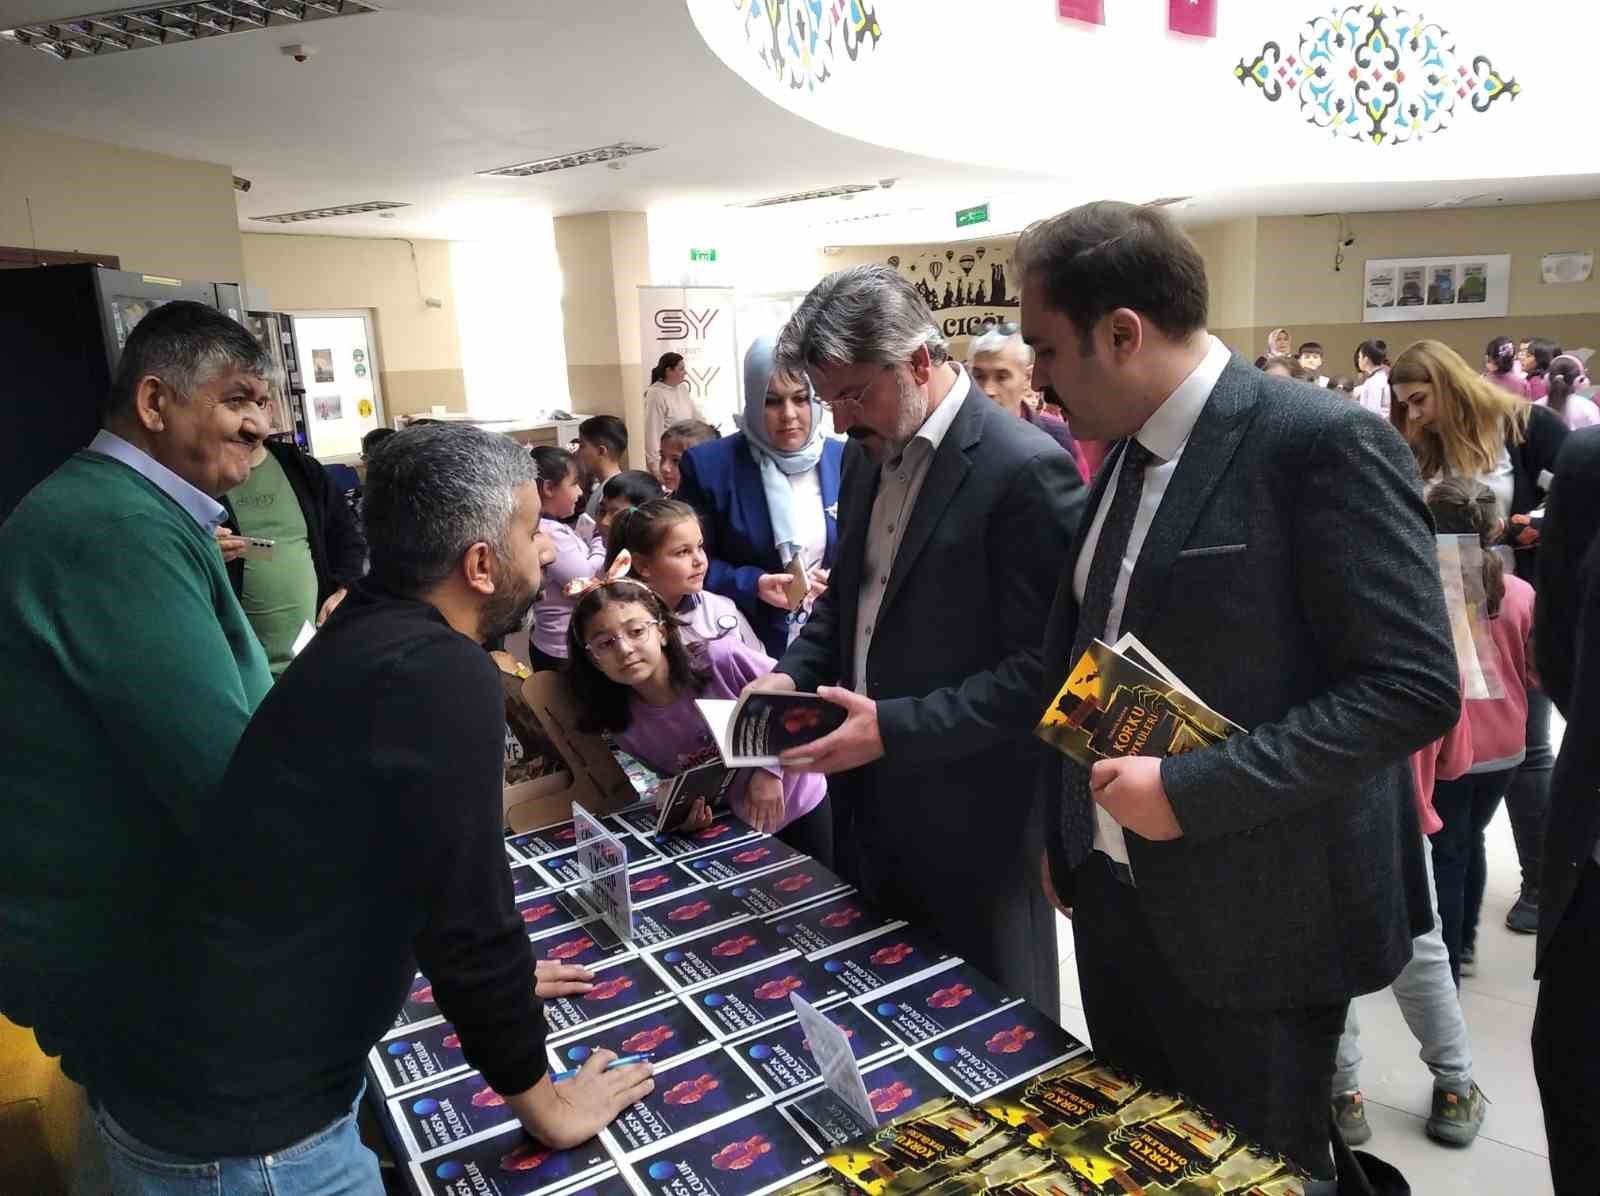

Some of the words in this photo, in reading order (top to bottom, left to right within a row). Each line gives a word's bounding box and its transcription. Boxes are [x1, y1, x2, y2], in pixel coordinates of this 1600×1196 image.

[1112, 705, 1145, 753] KORKU
[772, 1043, 812, 1082] YOLCULUK
[954, 1045, 1004, 1085] YOLCULUK
[439, 1098, 469, 1140] YOLCULUK
[1043, 1092, 1089, 1117] KORKU
[896, 1134, 936, 1159] KORKU
[1129, 1139, 1180, 1174] KORKU
